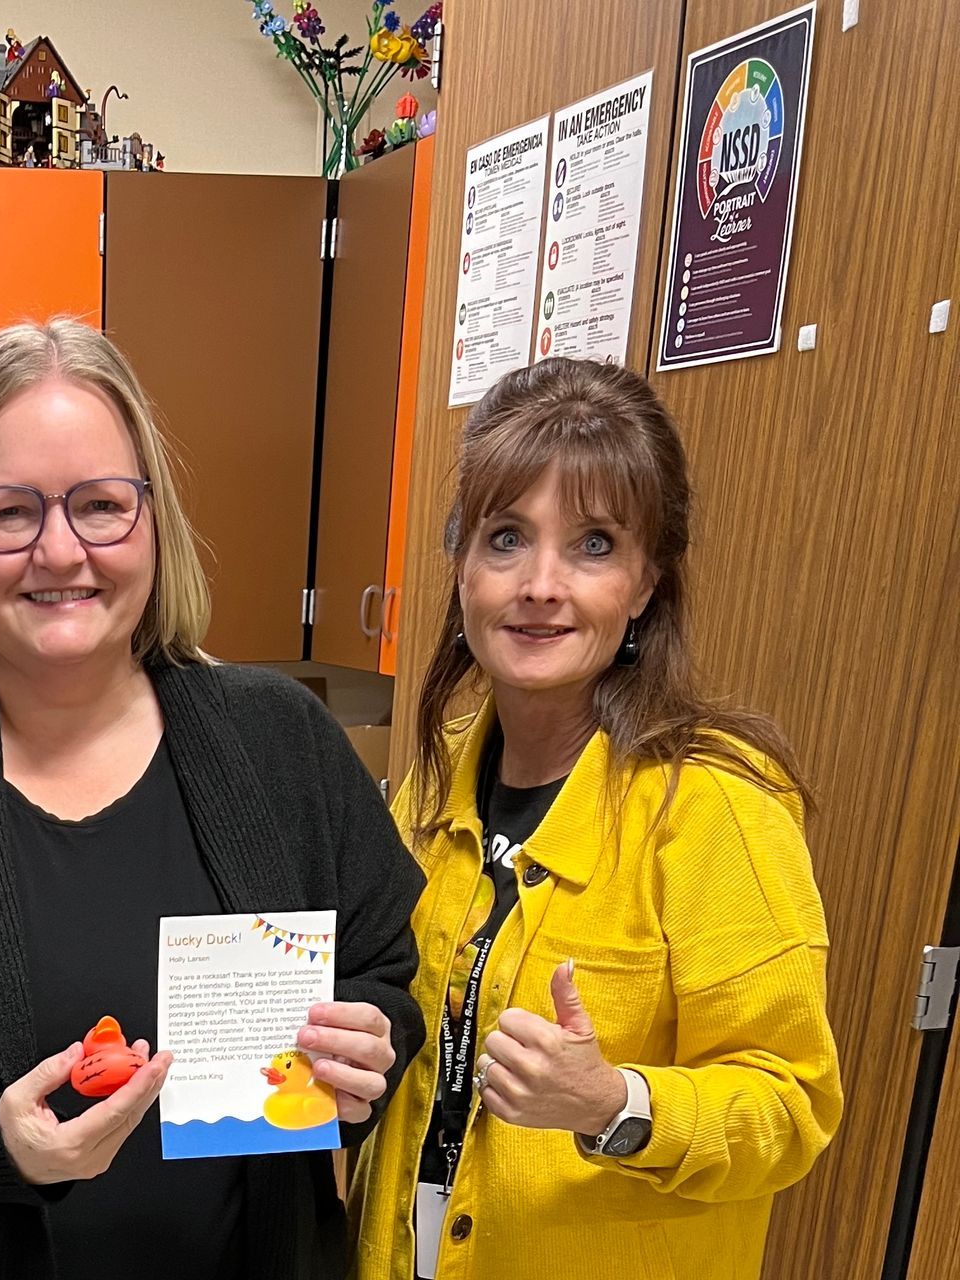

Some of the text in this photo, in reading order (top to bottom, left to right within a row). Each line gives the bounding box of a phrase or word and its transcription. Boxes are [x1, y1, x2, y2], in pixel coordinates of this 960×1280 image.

[558, 85, 647, 142] IN AN EMERGENCY
[576, 119, 621, 148] TAKE ACTION
[470, 132, 543, 174] EN CASO DE EMERGENCIA
[720, 123, 761, 173] NSSD
[714, 192, 756, 216] PORTRAIT
[710, 211, 752, 243] Learner
[168, 932, 242, 948] Lucky Duck!
[169, 956, 185, 964] Holly
[224, 990, 256, 998] workplace
[266, 988, 299, 996] imperative
[168, 1002, 194, 1010] positive
[451, 937, 492, 1092] North Sanpete School District
[198, 1028, 218, 1036] loving
[195, 1046, 227, 1054] genuinely
[264, 1052, 282, 1060] being
[208, 1072, 224, 1080] King
